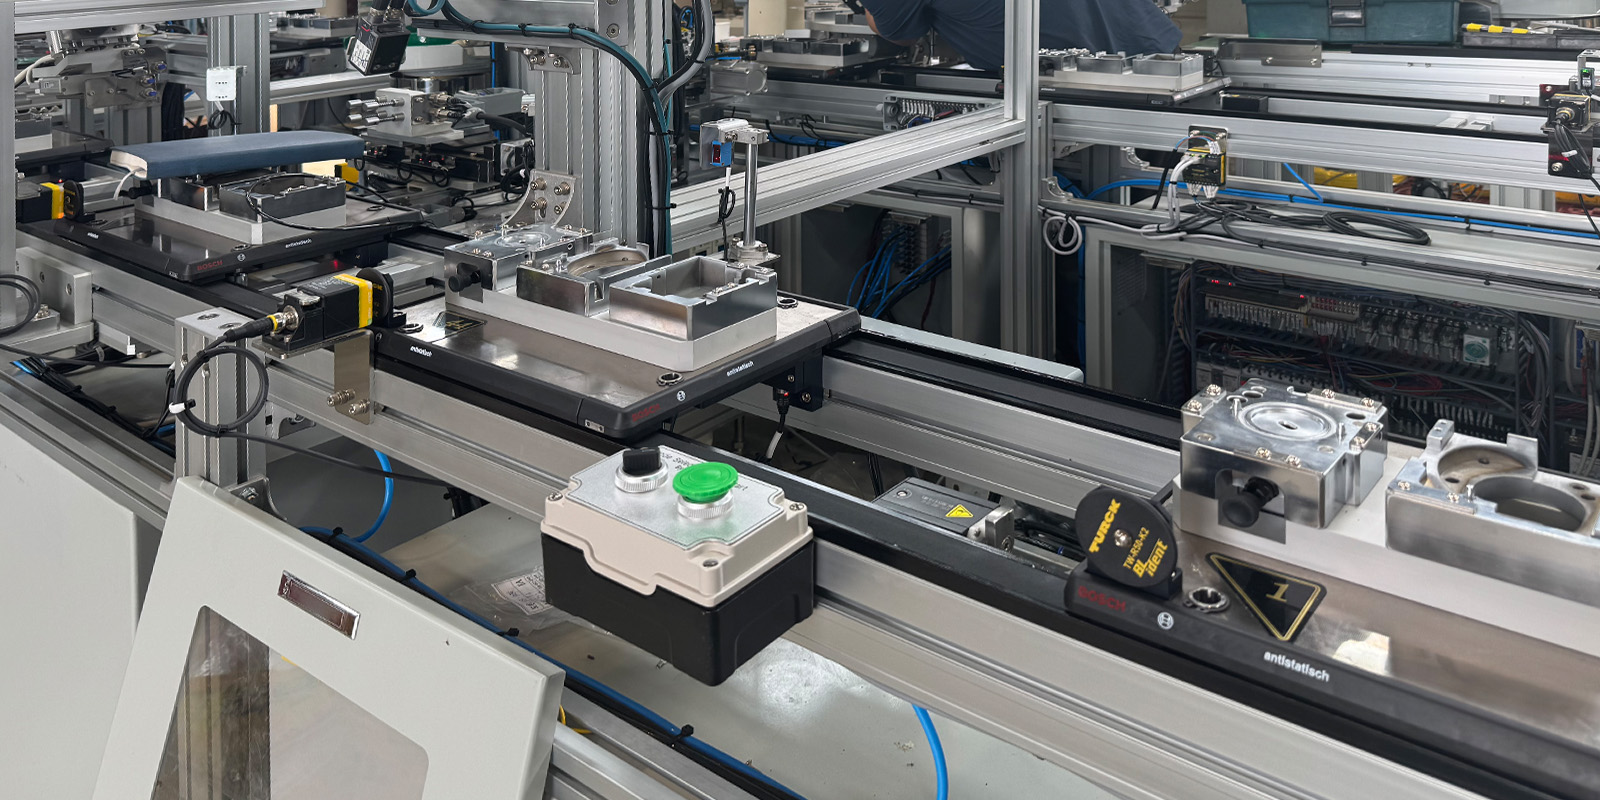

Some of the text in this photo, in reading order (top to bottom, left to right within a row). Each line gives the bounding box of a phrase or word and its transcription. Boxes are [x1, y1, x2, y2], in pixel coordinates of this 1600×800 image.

[197, 260, 223, 271] BOSCH
[1089, 499, 1121, 553] TURCK
[1123, 527, 1150, 569] TW-R50-K2
[1078, 585, 1126, 612] BOSCH
[1265, 582, 1289, 602] 1
[1263, 651, 1330, 682] antistatisch
